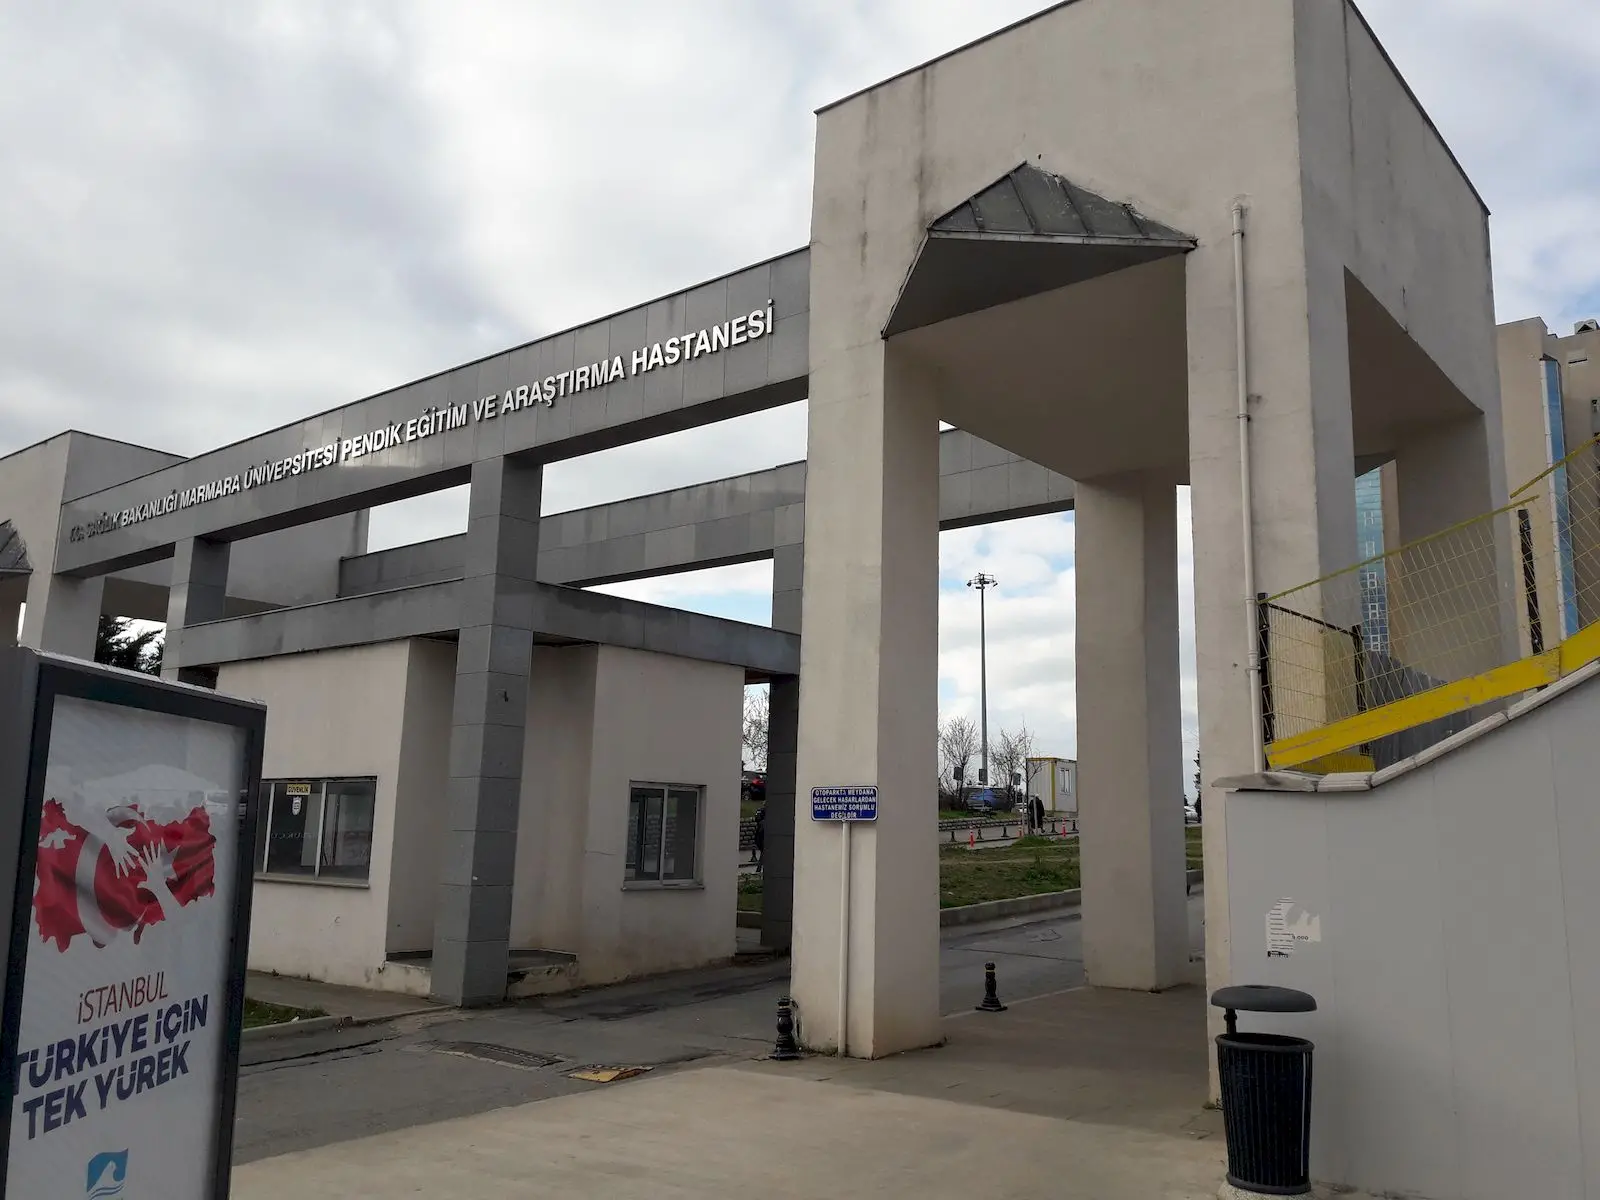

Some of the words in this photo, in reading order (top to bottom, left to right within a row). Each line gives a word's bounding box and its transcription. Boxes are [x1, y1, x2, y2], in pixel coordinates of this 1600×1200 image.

[179, 474, 242, 509] MARMARA
[341, 420, 403, 462] PENDİK
[406, 402, 469, 442] EĞİTİM
[473, 394, 498, 422] VE
[501, 356, 625, 407] ARAŞTIRMA
[631, 299, 775, 375] HASTANESİ
[23, 1078, 88, 1140] TEK
[95, 1040, 190, 1110] YÜREK
